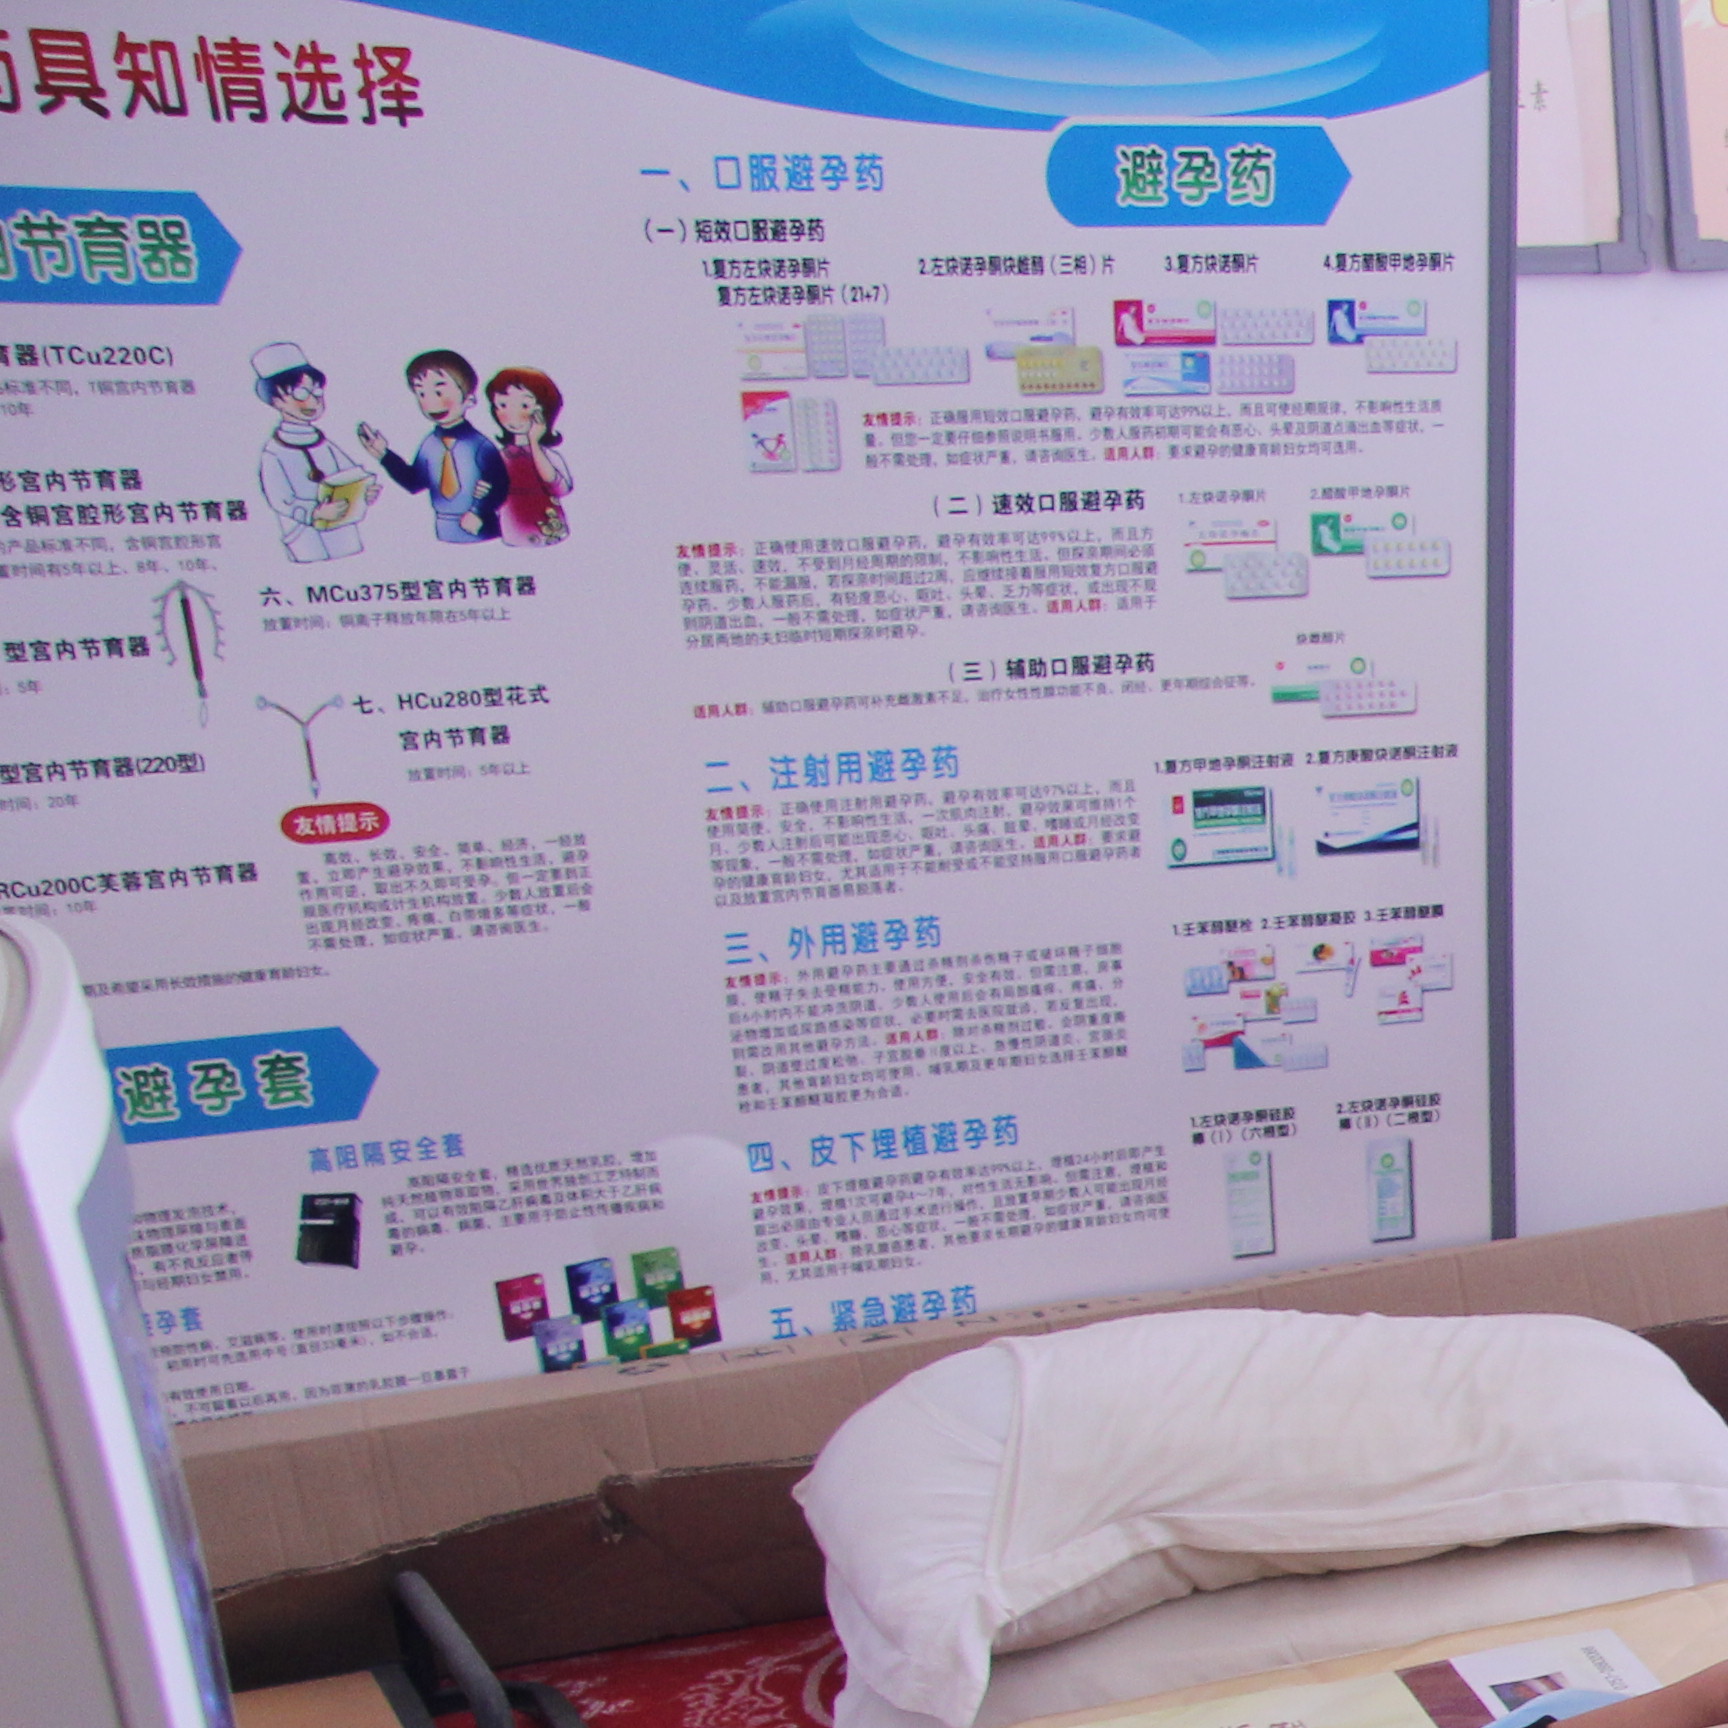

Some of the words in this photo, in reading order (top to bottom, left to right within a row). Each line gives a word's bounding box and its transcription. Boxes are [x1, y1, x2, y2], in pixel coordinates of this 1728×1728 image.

[0, 28, 425, 128] 具知情选择
[639, 153, 885, 193] 一、口服避孕药
[1118, 146, 1275, 205] 避孕药
[0, 214, 197, 282] 节育器
[399, 724, 511, 752] 宫内节育器
[705, 745, 958, 793] 二、注射用避孕药
[293, 811, 380, 837] 友情提示
[724, 915, 942, 965] 三、外用避孕药
[116, 1051, 313, 1124] 避孕套
[746, 1114, 1018, 1174] 四、皮下埋植避孕药
[769, 1284, 977, 1341] 五、紧急避孕药
